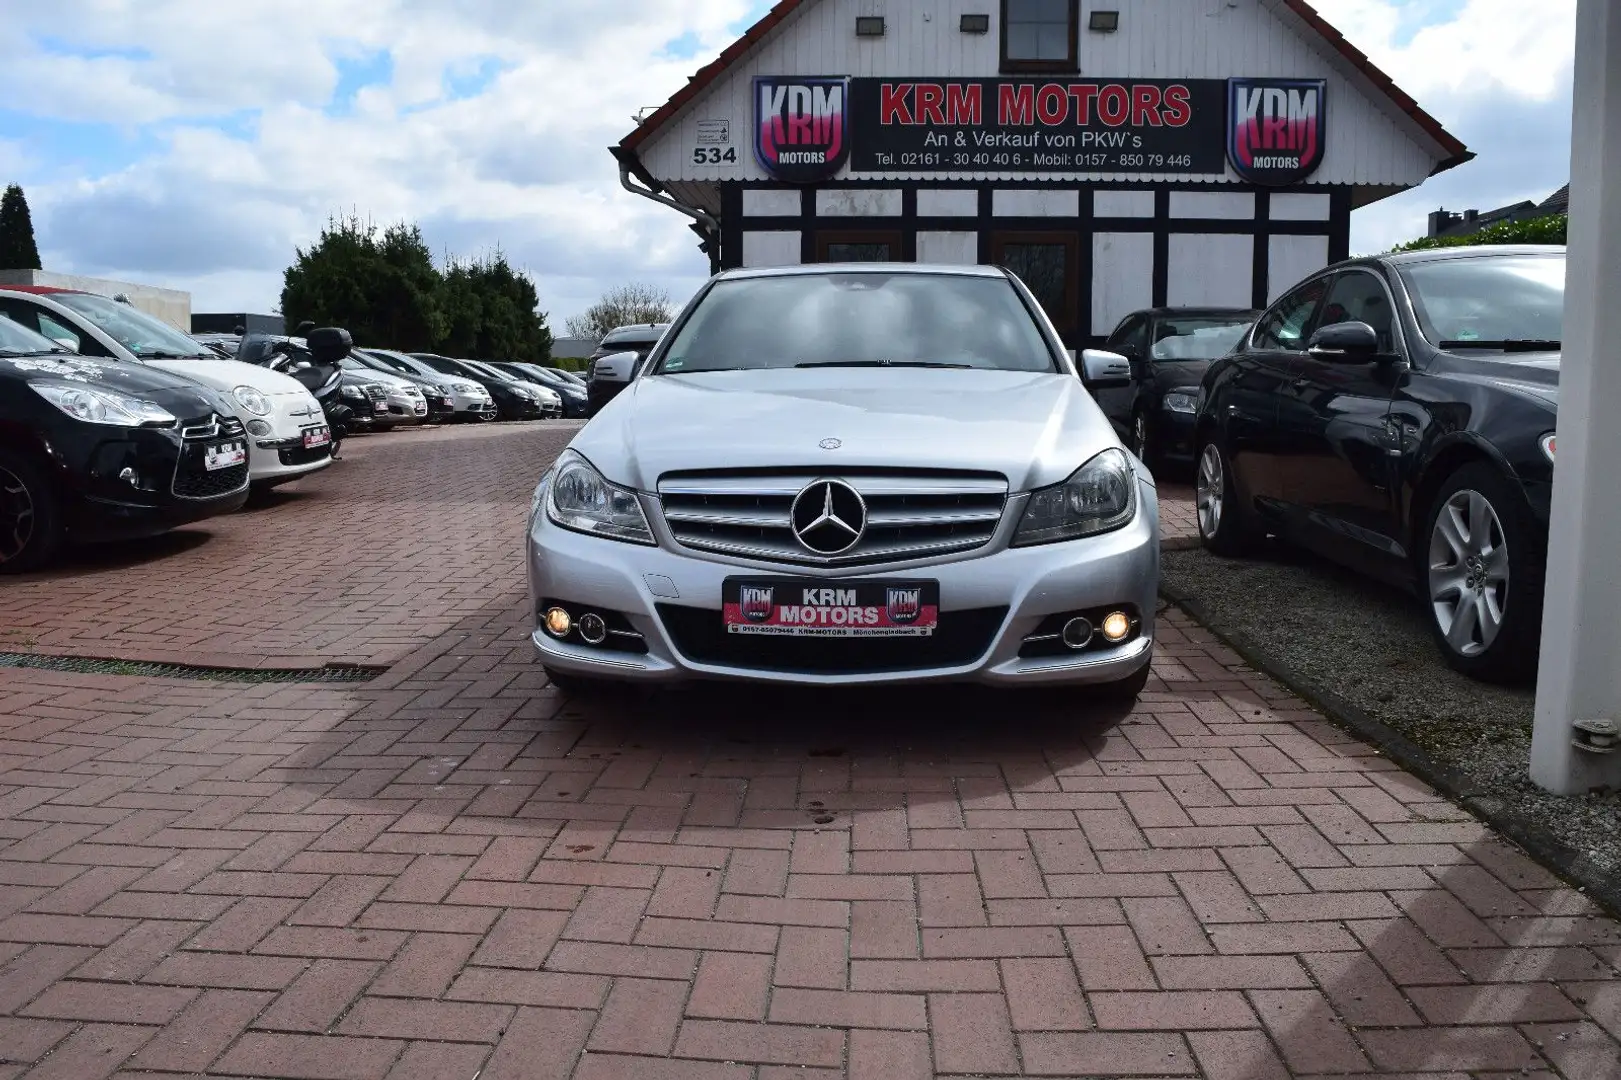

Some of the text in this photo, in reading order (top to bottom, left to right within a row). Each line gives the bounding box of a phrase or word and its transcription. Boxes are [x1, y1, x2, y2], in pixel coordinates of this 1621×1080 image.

[881, 83, 1191, 127] KRM MOTORS
[762, 85, 843, 156] KRM
[1237, 87, 1317, 158] KRM
[924, 131, 948, 147] An
[954, 131, 966, 147] &
[973, 131, 1040, 147] Verkauf
[1045, 135, 1075, 147] von
[693, 147, 737, 164] 534
[779, 151, 826, 165] MOTORS
[875, 153, 896, 165] Tel.
[901, 153, 940, 165] 02161
[953, 153, 969, 165] 30
[973, 153, 989, 165] 40
[992, 153, 1009, 165] 40
[1012, 153, 1021, 165] 6
[1033, 153, 1071, 166] Mobil:
[1075, 153, 1107, 166] 0157
[1119, 154, 1144, 166] 850
[1148, 154, 1163, 166] 79
[1167, 154, 1191, 167] 446
[1253, 156, 1300, 169] MOTORS
[803, 588, 856, 606] KRM
[780, 605, 879, 624] MOTORS
